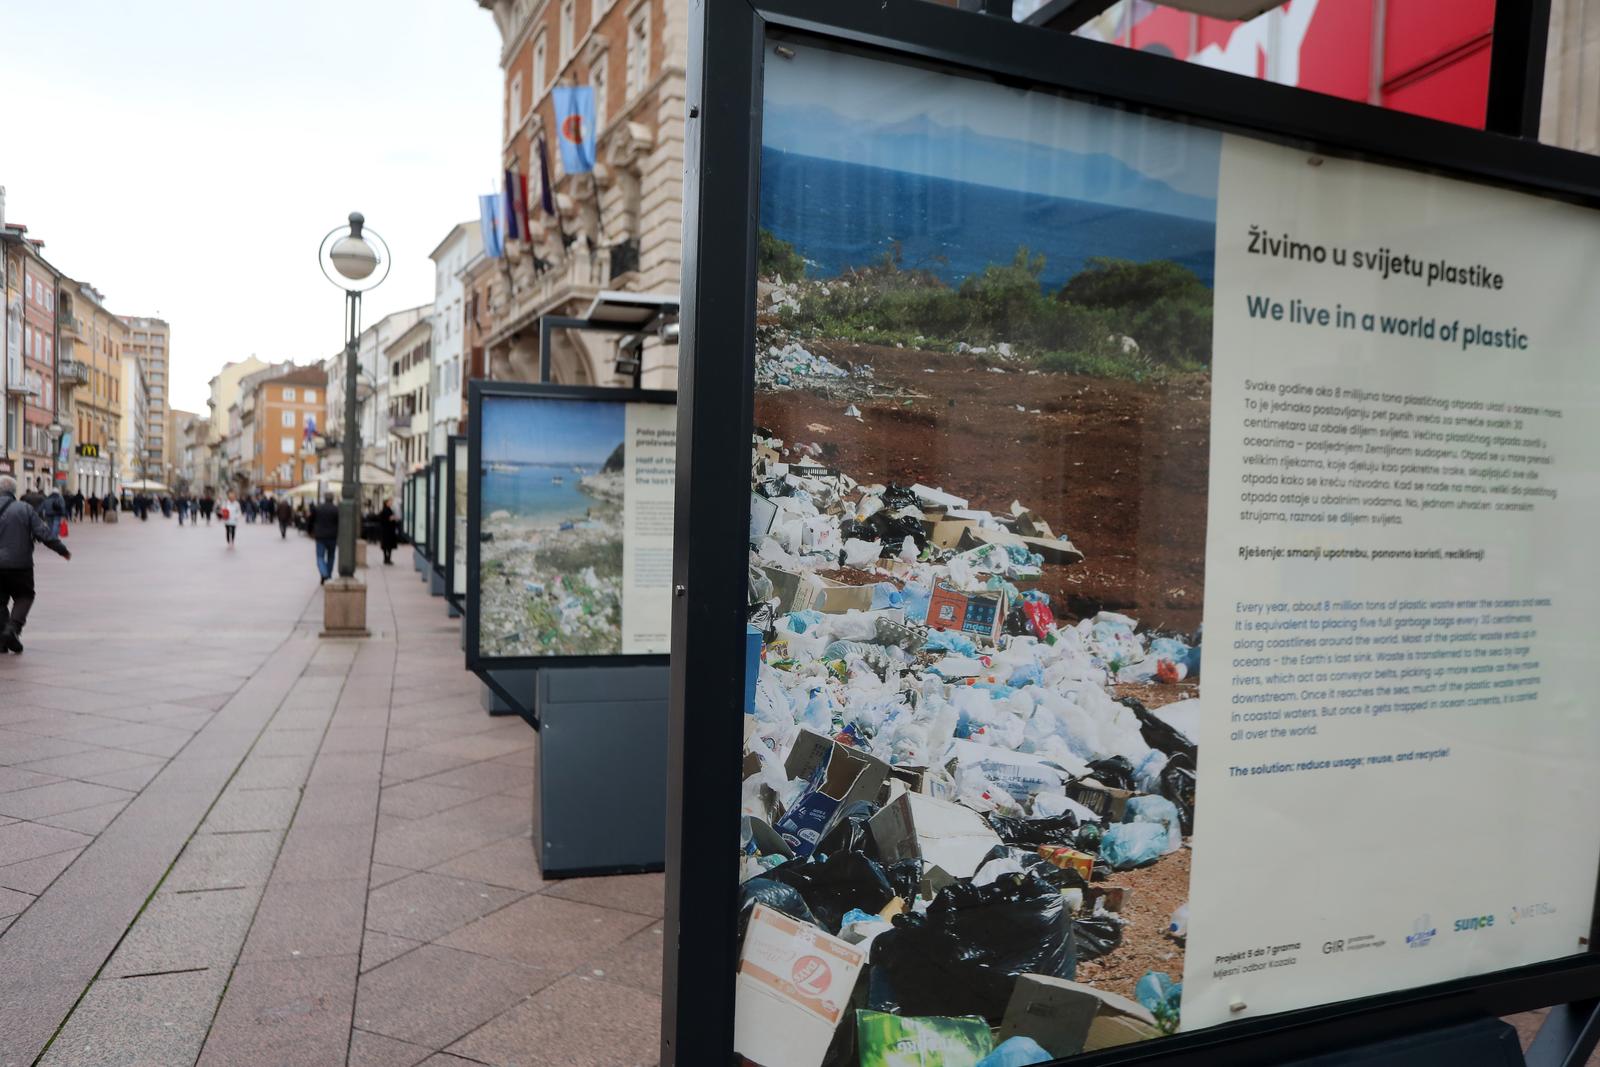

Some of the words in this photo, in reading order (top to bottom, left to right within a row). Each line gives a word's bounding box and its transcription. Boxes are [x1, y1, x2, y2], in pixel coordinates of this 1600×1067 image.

[1247, 225, 1327, 263] Živimo
[1332, 248, 1347, 266] u
[1352, 248, 1423, 279] svijetu
[1428, 260, 1504, 290] plastike
[1246, 295, 1285, 320] We
[1289, 300, 1331, 327] live
[1336, 304, 1356, 329] in
[1361, 313, 1375, 332] a
[1380, 317, 1435, 340] world
[1439, 321, 1459, 342] of
[1462, 324, 1529, 350] plastic
[1244, 379, 1276, 392] Svake
[1278, 384, 1313, 396] godine
[1315, 386, 1332, 397] oko
[1245, 398, 1257, 409] To
[1259, 399, 1269, 413] je
[1270, 400, 1311, 414] jednako
[1243, 417, 1305, 432] centimetara
[1308, 424, 1318, 432] uz
[1320, 423, 1347, 434] obale
[1243, 437, 1294, 448] oceanima
[1242, 454, 1278, 466] velikim
[1327, 459, 1346, 472] koje
[1241, 473, 1279, 487] otpada
[1280, 474, 1305, 485] kako
[1307, 478, 1317, 486] se
[1240, 492, 1277, 504] otpada
[1280, 493, 1309, 507] ostaje
[1320, 494, 1360, 505] obalnim
[1290, 512, 1324, 522] raznosi
[1286, 547, 1321, 560] smanji
[1236, 602, 1264, 615] Every
[1292, 601, 1322, 612] about
[1332, 600, 1363, 611] million
[1243, 620, 1252, 631] is
[1254, 619, 1307, 633] equivalent
[1309, 619, 1320, 629] to
[1321, 618, 1357, 631] placing
[1359, 617, 1376, 627] five
[1233, 639, 1264, 652] along
[1266, 637, 1316, 648] coastlines
[1318, 636, 1353, 647] around
[1355, 634, 1370, 645] the
[1232, 657, 1271, 667] oceans
[1281, 656, 1297, 665] the
[1334, 654, 1352, 663] last
[1265, 673, 1296, 684] which
[1297, 673, 1313, 683] act
[1315, 673, 1328, 682] as
[1330, 671, 1373, 682] conveyor
[1301, 690, 1327, 700] Once
[1337, 688, 1375, 698] reaches
[1231, 712, 1242, 722] in
[1243, 709, 1282, 721] coastal
[1321, 707, 1337, 717] But
[1339, 706, 1363, 715] once
[1230, 730, 1244, 741] all
[1246, 730, 1267, 740] over
[1269, 728, 1287, 737] the
[1229, 767, 1249, 776] The
[1297, 760, 1331, 770] reduce
[1215, 951, 1246, 964] Projekt
[1247, 948, 1253, 959] 5
[1254, 947, 1265, 957] do
[1267, 945, 1272, 955] 7
[1272, 942, 1301, 956] grama
[1322, 939, 1344, 954] GIR
